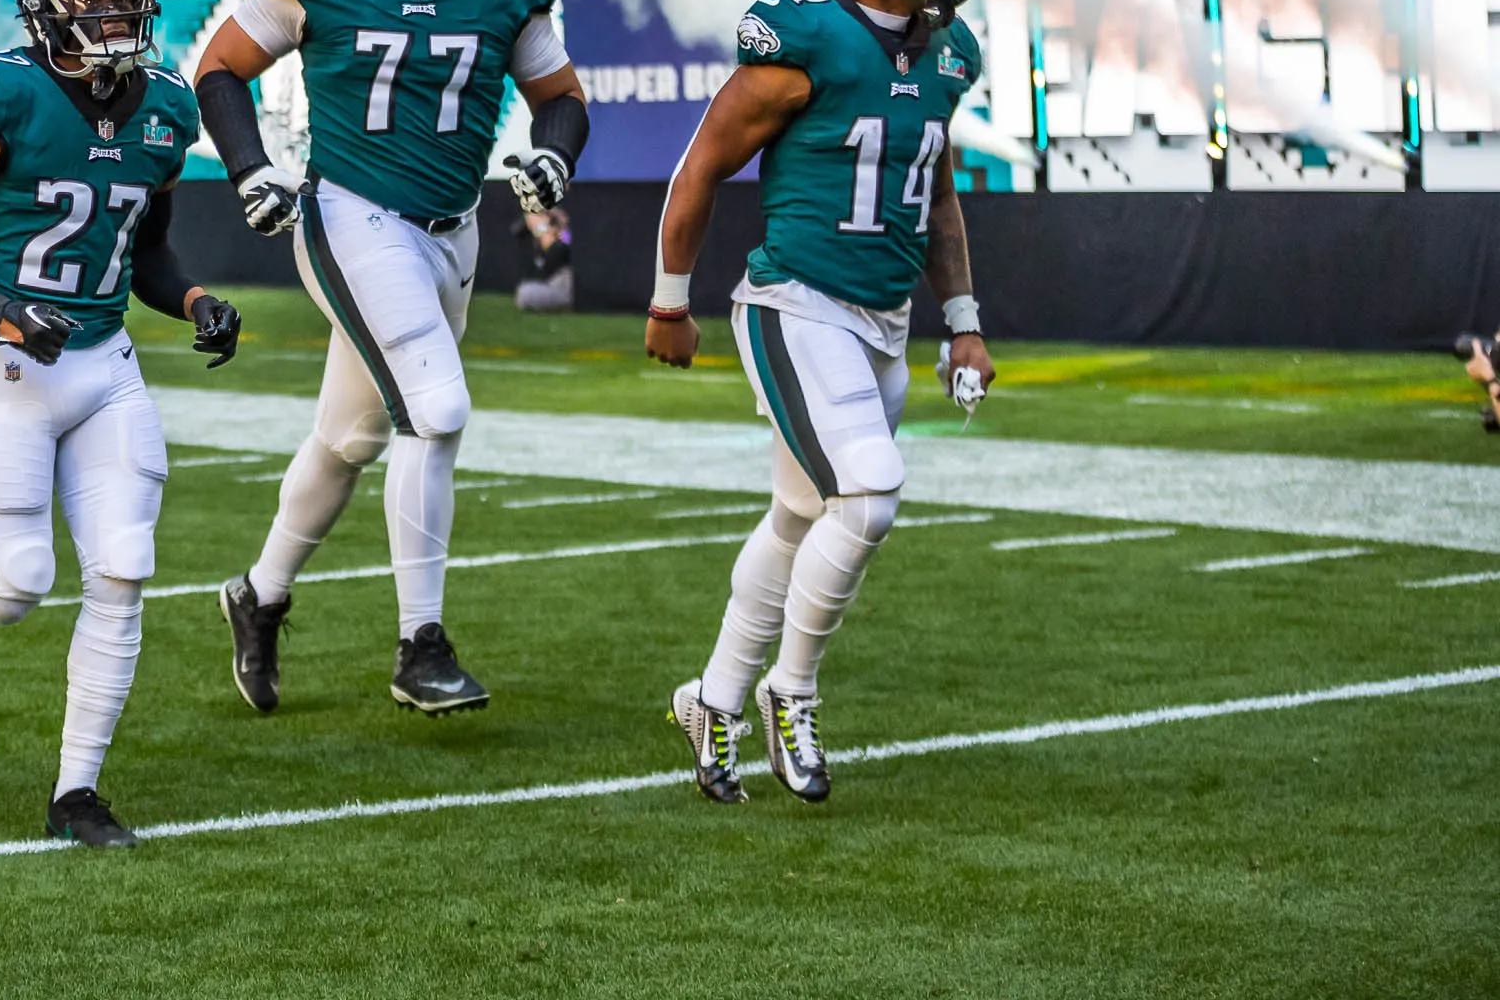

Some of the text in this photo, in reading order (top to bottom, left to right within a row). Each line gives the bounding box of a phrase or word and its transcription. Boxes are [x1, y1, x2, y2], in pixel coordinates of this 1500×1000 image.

[355, 29, 480, 133] 77
[577, 64, 679, 104] SUPER
[88, 147, 123, 162] EAGLES
[836, 116, 948, 235] 14
[15, 177, 151, 298] 27
